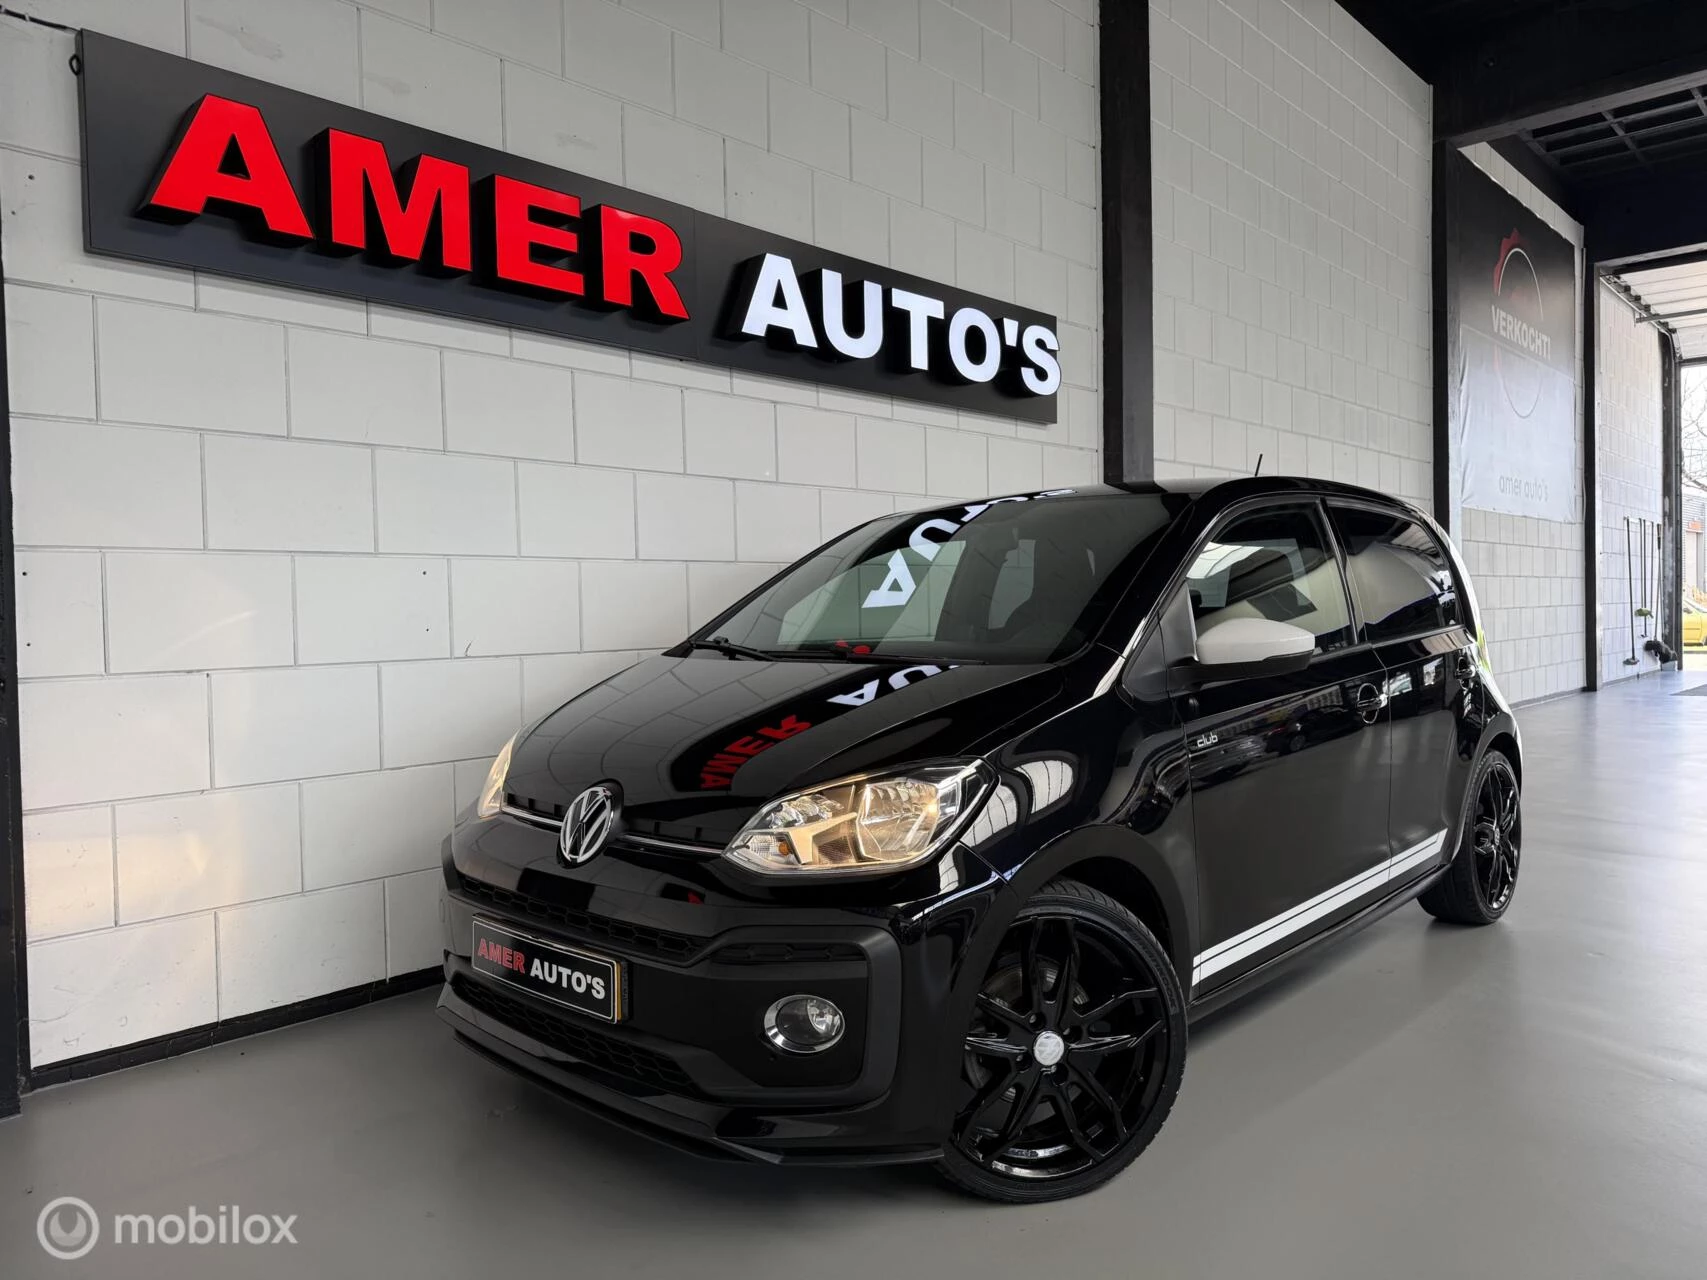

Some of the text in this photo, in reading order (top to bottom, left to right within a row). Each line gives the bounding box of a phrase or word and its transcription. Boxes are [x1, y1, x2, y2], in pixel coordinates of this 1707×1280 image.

[150, 93, 1062, 396] AMER AUTO'S
[1499, 475, 1522, 498] amer
[1197, 732, 1219, 748] club
[477, 938, 606, 1000] AMER AUTO'S
